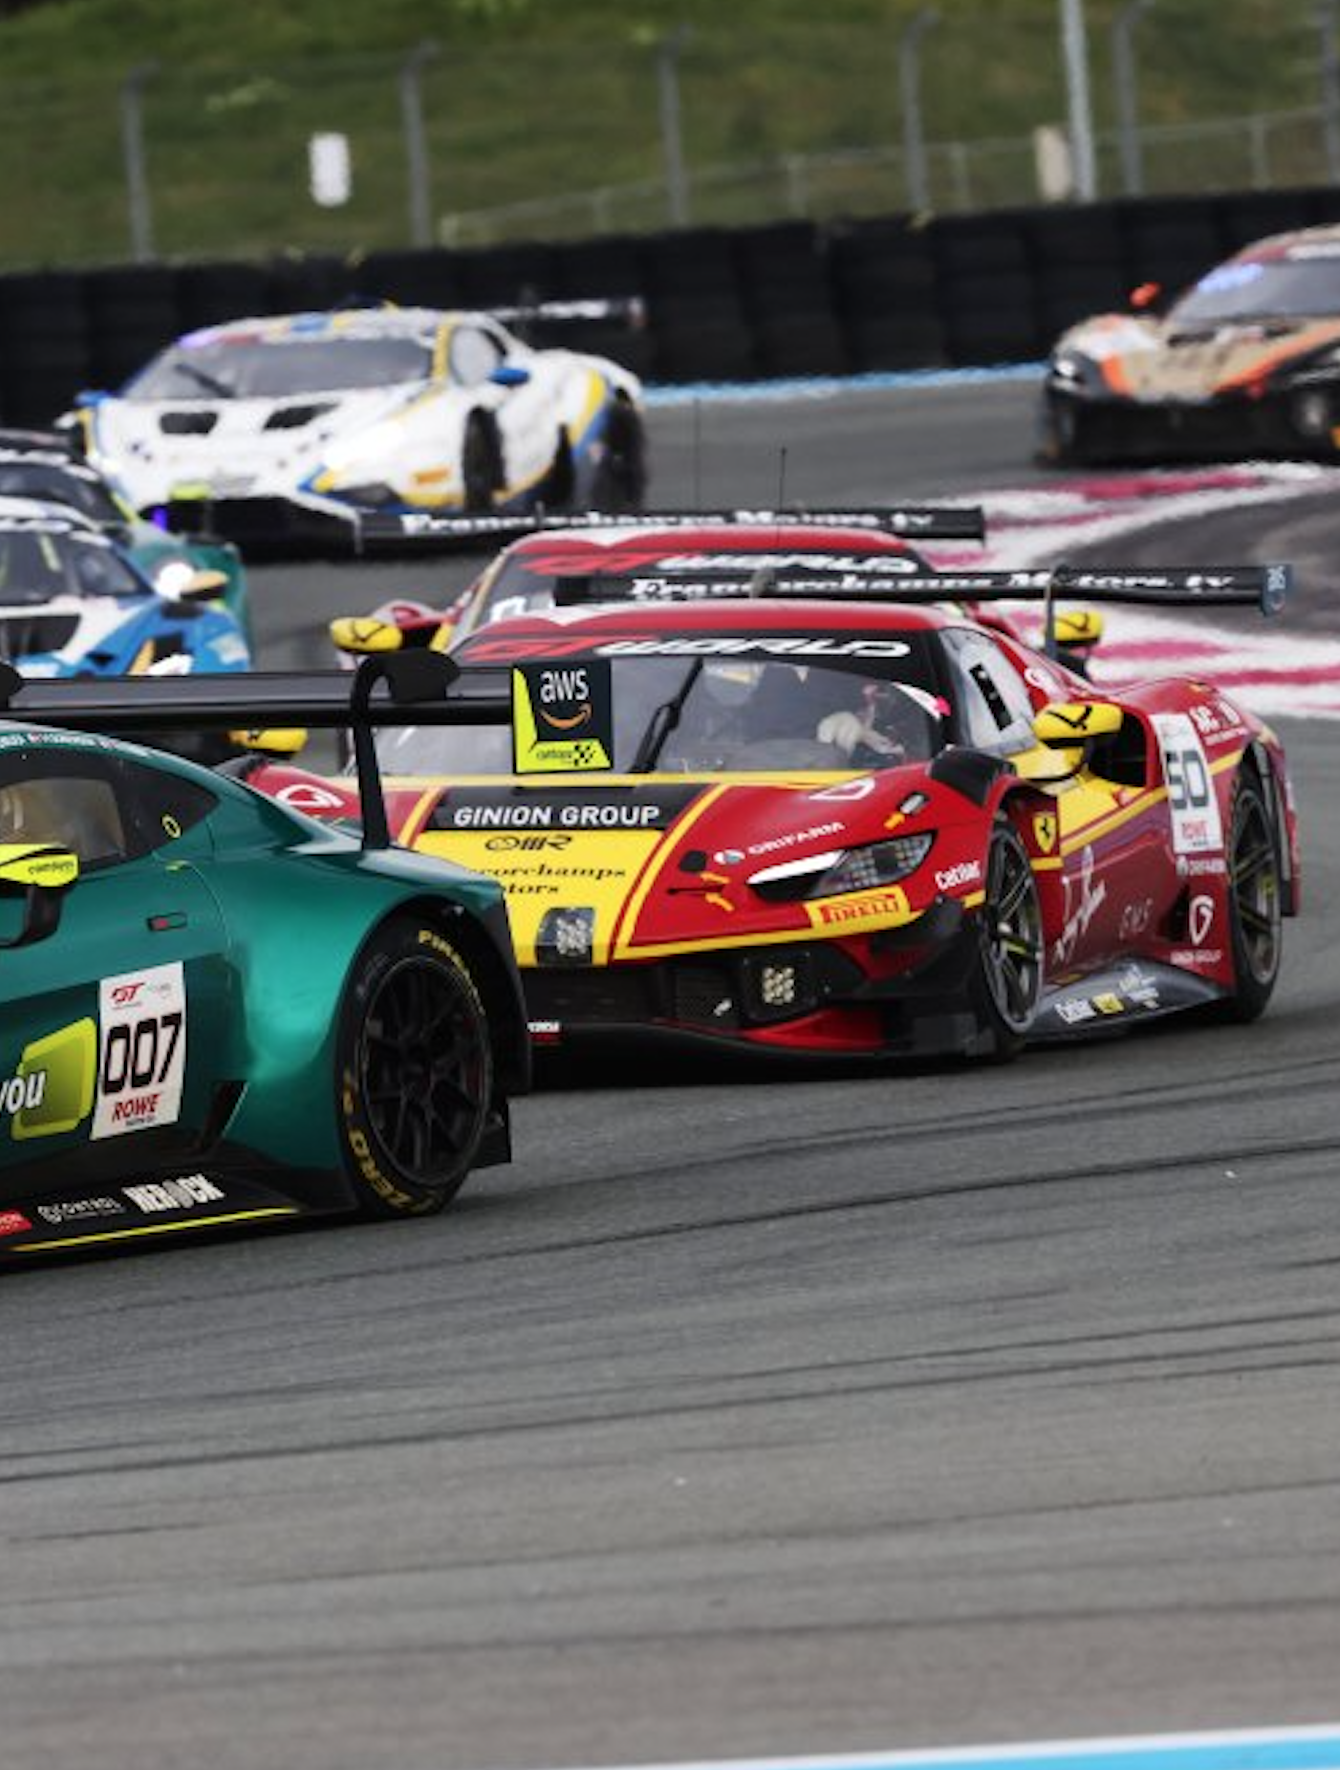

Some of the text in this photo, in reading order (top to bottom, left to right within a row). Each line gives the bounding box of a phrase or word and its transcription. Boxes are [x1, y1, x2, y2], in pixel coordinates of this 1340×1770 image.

[593, 637, 912, 658] WORLD
[541, 668, 590, 704] aws
[453, 804, 661, 827] GINION GROUP
[818, 894, 901, 925] PIRELLI
[103, 1011, 182, 1095] 007
